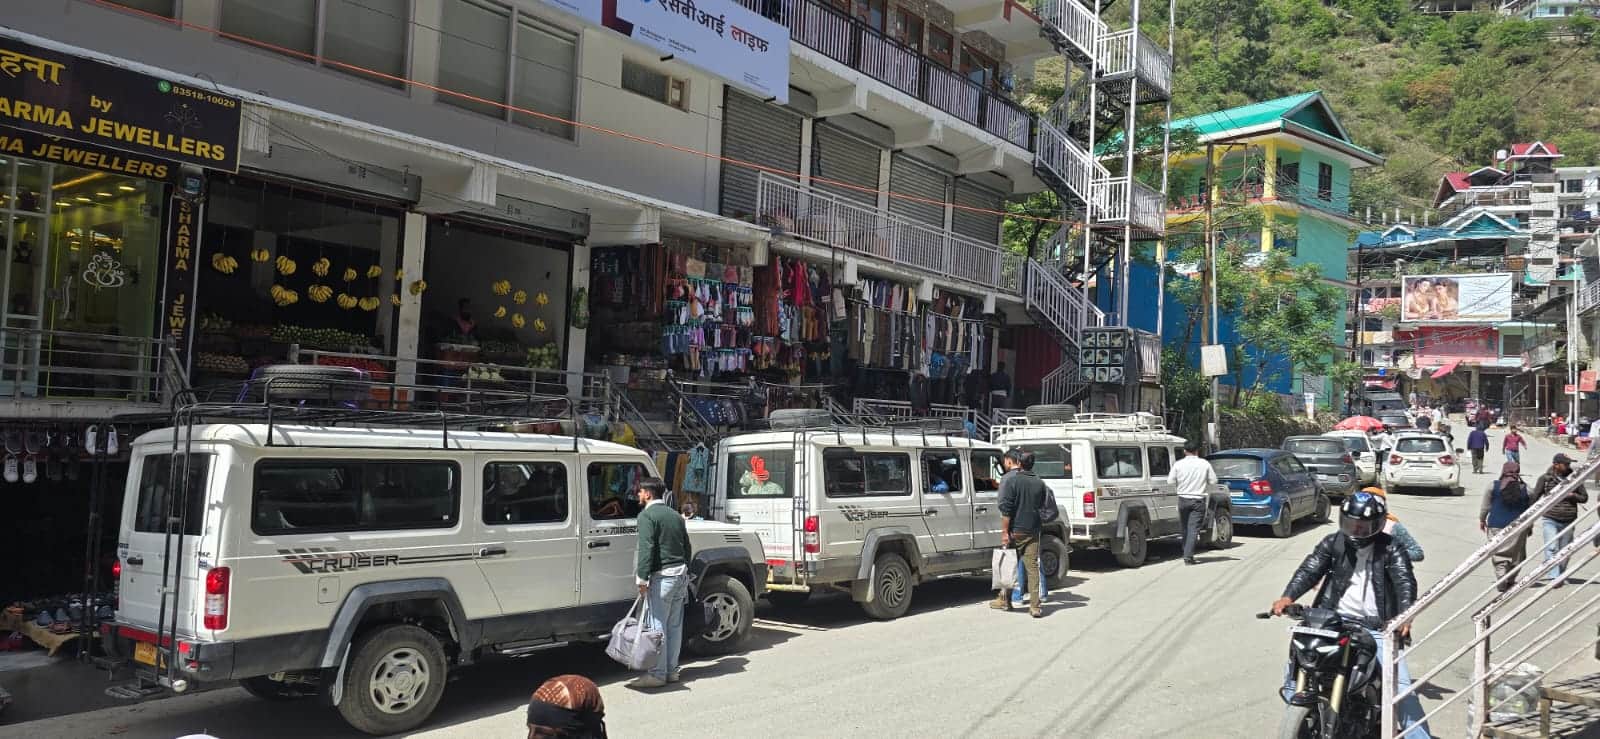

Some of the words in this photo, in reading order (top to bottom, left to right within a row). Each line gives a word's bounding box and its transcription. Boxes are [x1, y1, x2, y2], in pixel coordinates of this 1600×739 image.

[730, 25, 769, 52] लाइफ
[90, 96, 112, 112] by
[172, 86, 236, 108] 83518-10029
[82, 117, 225, 161] JEWELLERS
[32, 143, 168, 178] JEWELLERS
[176, 200, 192, 271] SHARMA
[310, 554, 399, 570] CRUISER
